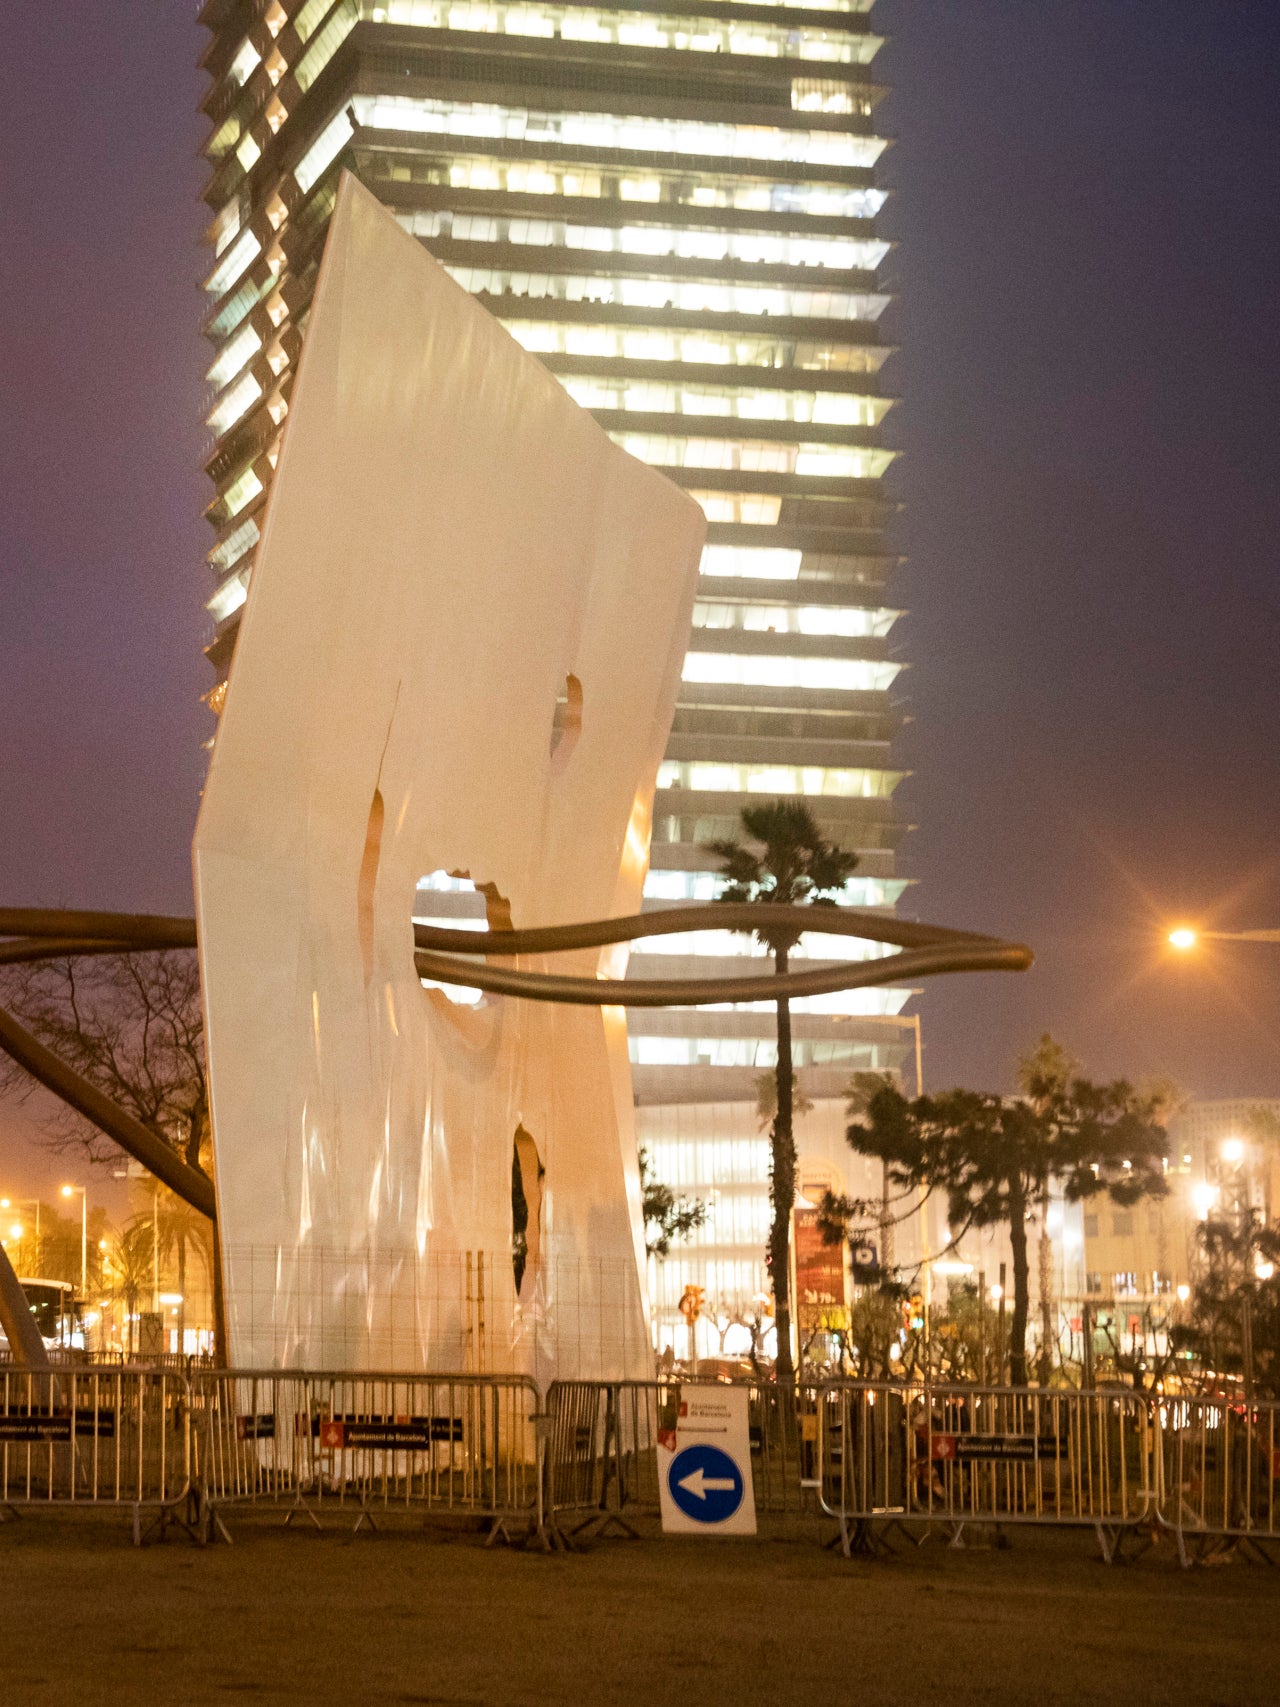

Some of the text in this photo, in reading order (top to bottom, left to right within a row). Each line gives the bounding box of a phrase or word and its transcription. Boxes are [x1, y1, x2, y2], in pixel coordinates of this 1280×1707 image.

[28, 1425, 36, 1433] de
[37, 1425, 69, 1433] Barcelona
[348, 1432, 426, 1442] Ajuntament de Barcelona
